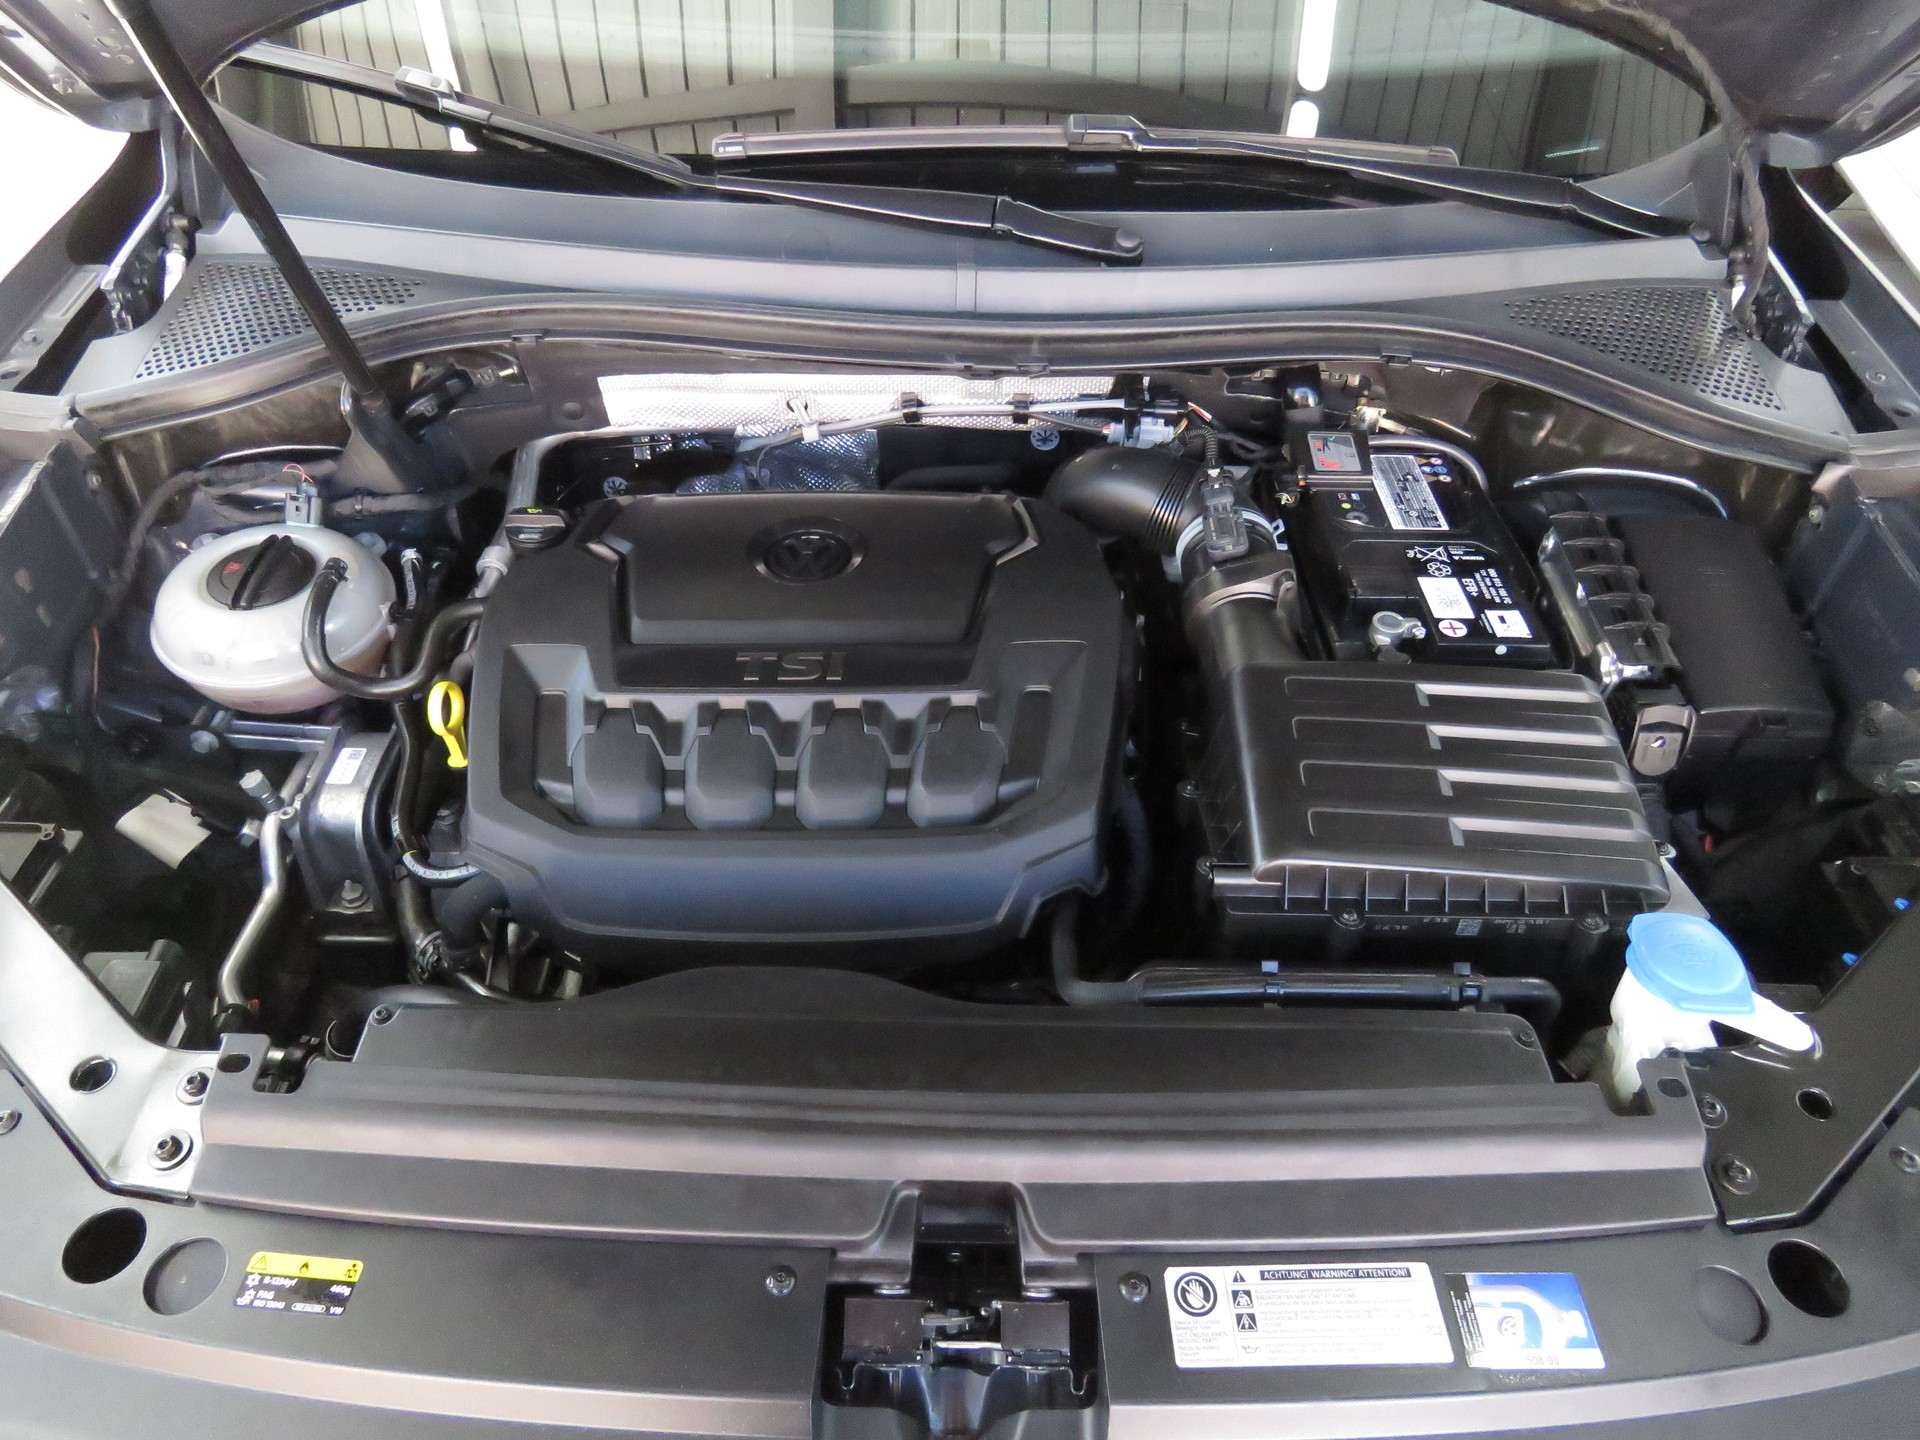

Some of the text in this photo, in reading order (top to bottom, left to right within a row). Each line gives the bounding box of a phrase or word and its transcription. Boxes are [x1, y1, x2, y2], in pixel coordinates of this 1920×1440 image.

[1461, 578, 1479, 597] EFB+
[735, 651, 846, 681] TSI
[1263, 1267, 1408, 1280] ACHTUNG! WARNING! ATTENTION!
[255, 1290, 275, 1299] PAG
[329, 1306, 345, 1315] VW
[1526, 1355, 1544, 1366] 508
